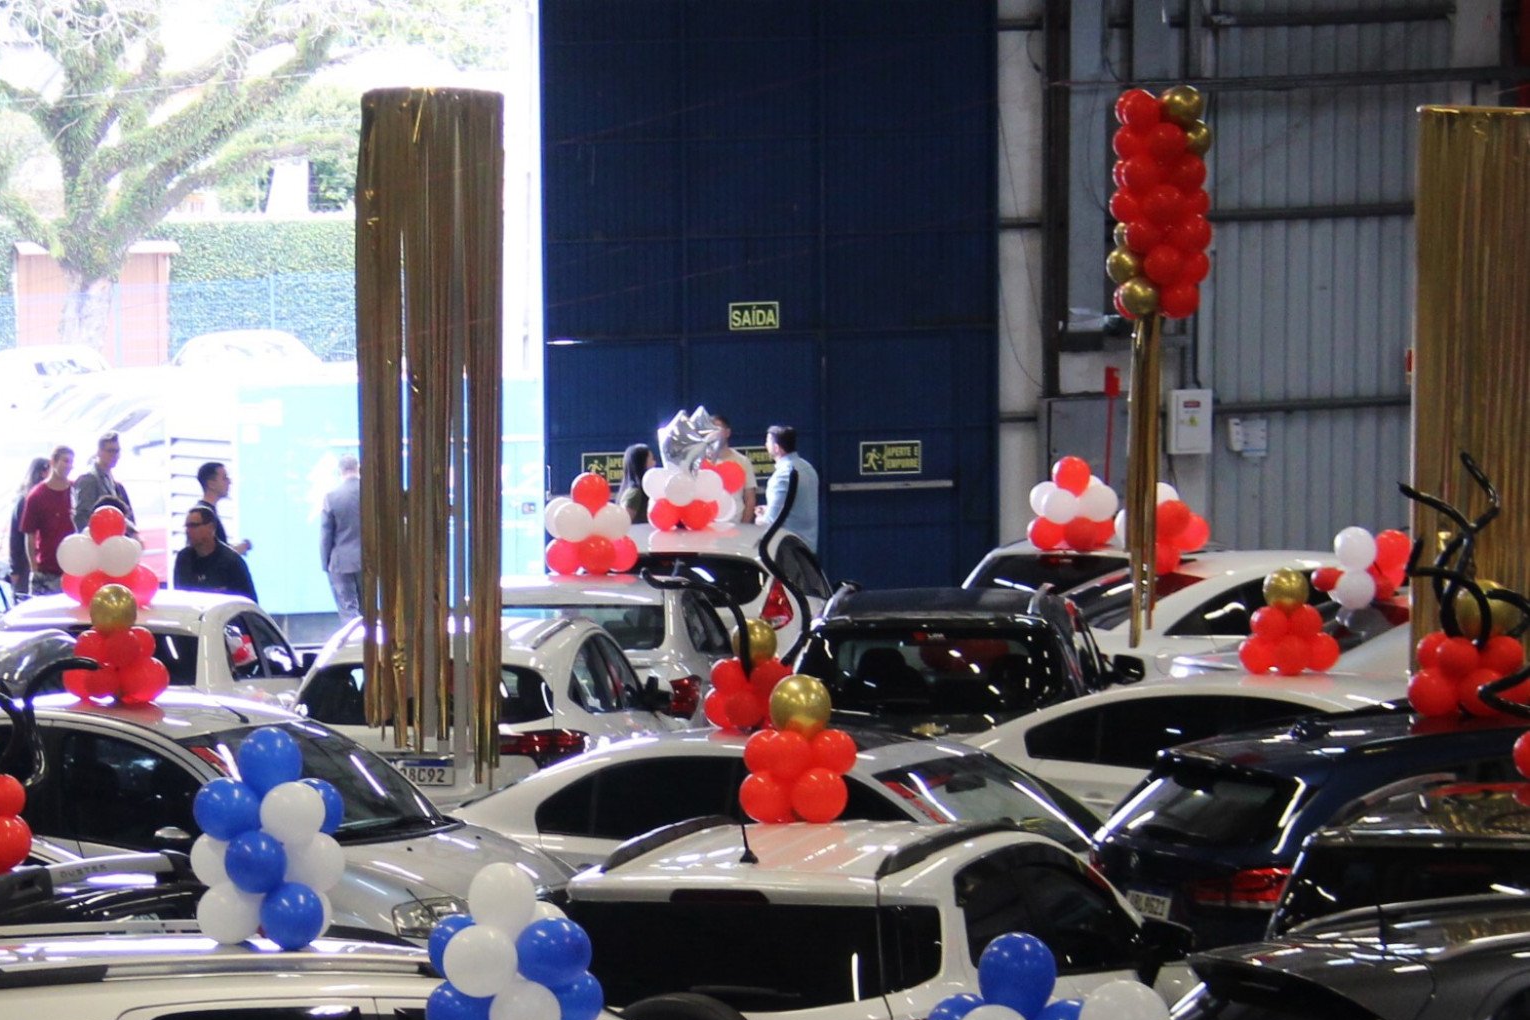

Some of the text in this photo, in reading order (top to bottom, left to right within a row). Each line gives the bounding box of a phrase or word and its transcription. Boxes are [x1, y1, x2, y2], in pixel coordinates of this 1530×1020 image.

[732, 305, 776, 327] SAÍDA
[885, 447, 911, 457] APERTE
[885, 458, 919, 469] EMPURRE
